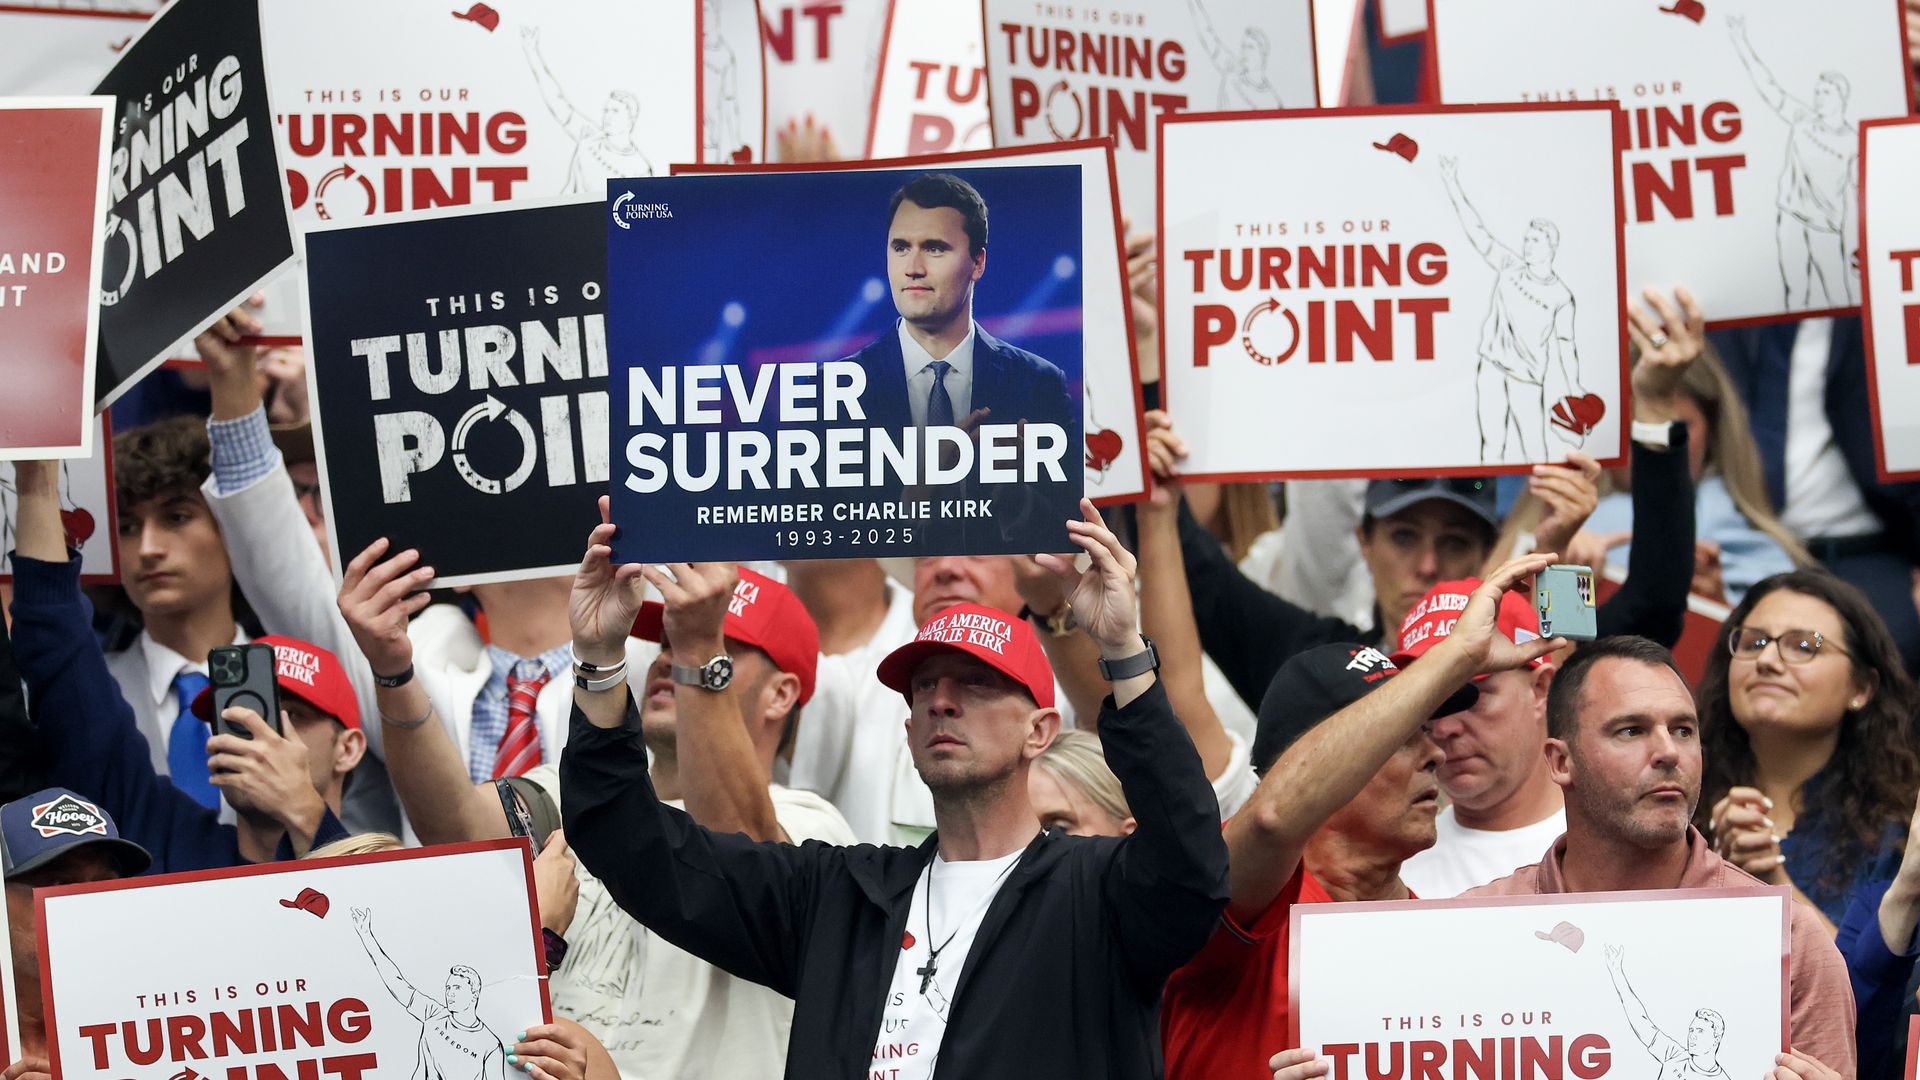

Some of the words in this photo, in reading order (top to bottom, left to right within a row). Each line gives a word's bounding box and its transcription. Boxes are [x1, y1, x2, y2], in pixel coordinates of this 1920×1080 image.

[1035, 4, 1074, 19] THIS
[1083, 9, 1100, 22] IS
[1109, 12, 1146, 26] OUR
[1001, 22, 1187, 83] TURNING
[136, 93, 153, 119] IS
[161, 53, 199, 95] OUR
[305, 89, 362, 103] THIS
[379, 88, 402, 101] IS
[419, 88, 470, 101] OUR
[1634, 81, 1682, 97] OUR
[106, 54, 243, 212] RNING
[277, 111, 528, 157] URNING
[100, 117, 250, 306] OINT
[625, 203, 669, 212] TURNING
[625, 211, 655, 220] POINT
[656, 210, 674, 219] USA
[1235, 223, 1288, 236] THIS
[1303, 221, 1326, 234] IS
[1342, 219, 1391, 233] OUR
[1183, 242, 1449, 293] TURNING
[425, 290, 506, 317] THIS
[527, 285, 560, 307] IS
[1193, 297, 1450, 368] POINT
[350, 313, 610, 401] TURNI
[628, 361, 868, 427] NEVER
[373, 390, 611, 504] POI
[624, 421, 1069, 494] SURRENDER
[697, 506, 824, 525] REMEMBER
[832, 502, 931, 521] CHARLIE
[939, 499, 993, 518] KIRK
[775, 527, 914, 547] 1993-2025
[1426, 593, 1470, 613] AMER
[946, 613, 1013, 642] AMERICA
[966, 629, 1006, 655] KIRK
[278, 660, 315, 687] KIRK
[45, 810, 97, 826] Hooey
[136, 990, 198, 1009] THIS
[214, 986, 238, 1001] IS
[255, 978, 308, 996] OUR
[78, 997, 373, 1071] TURNING
[1382, 1016, 1442, 1031] THIS
[1460, 1013, 1483, 1028] IS
[1500, 1010, 1552, 1026] OUR
[434, 1026, 478, 1059] FREEDOM
[1321, 1033, 1612, 1080] TURNING
